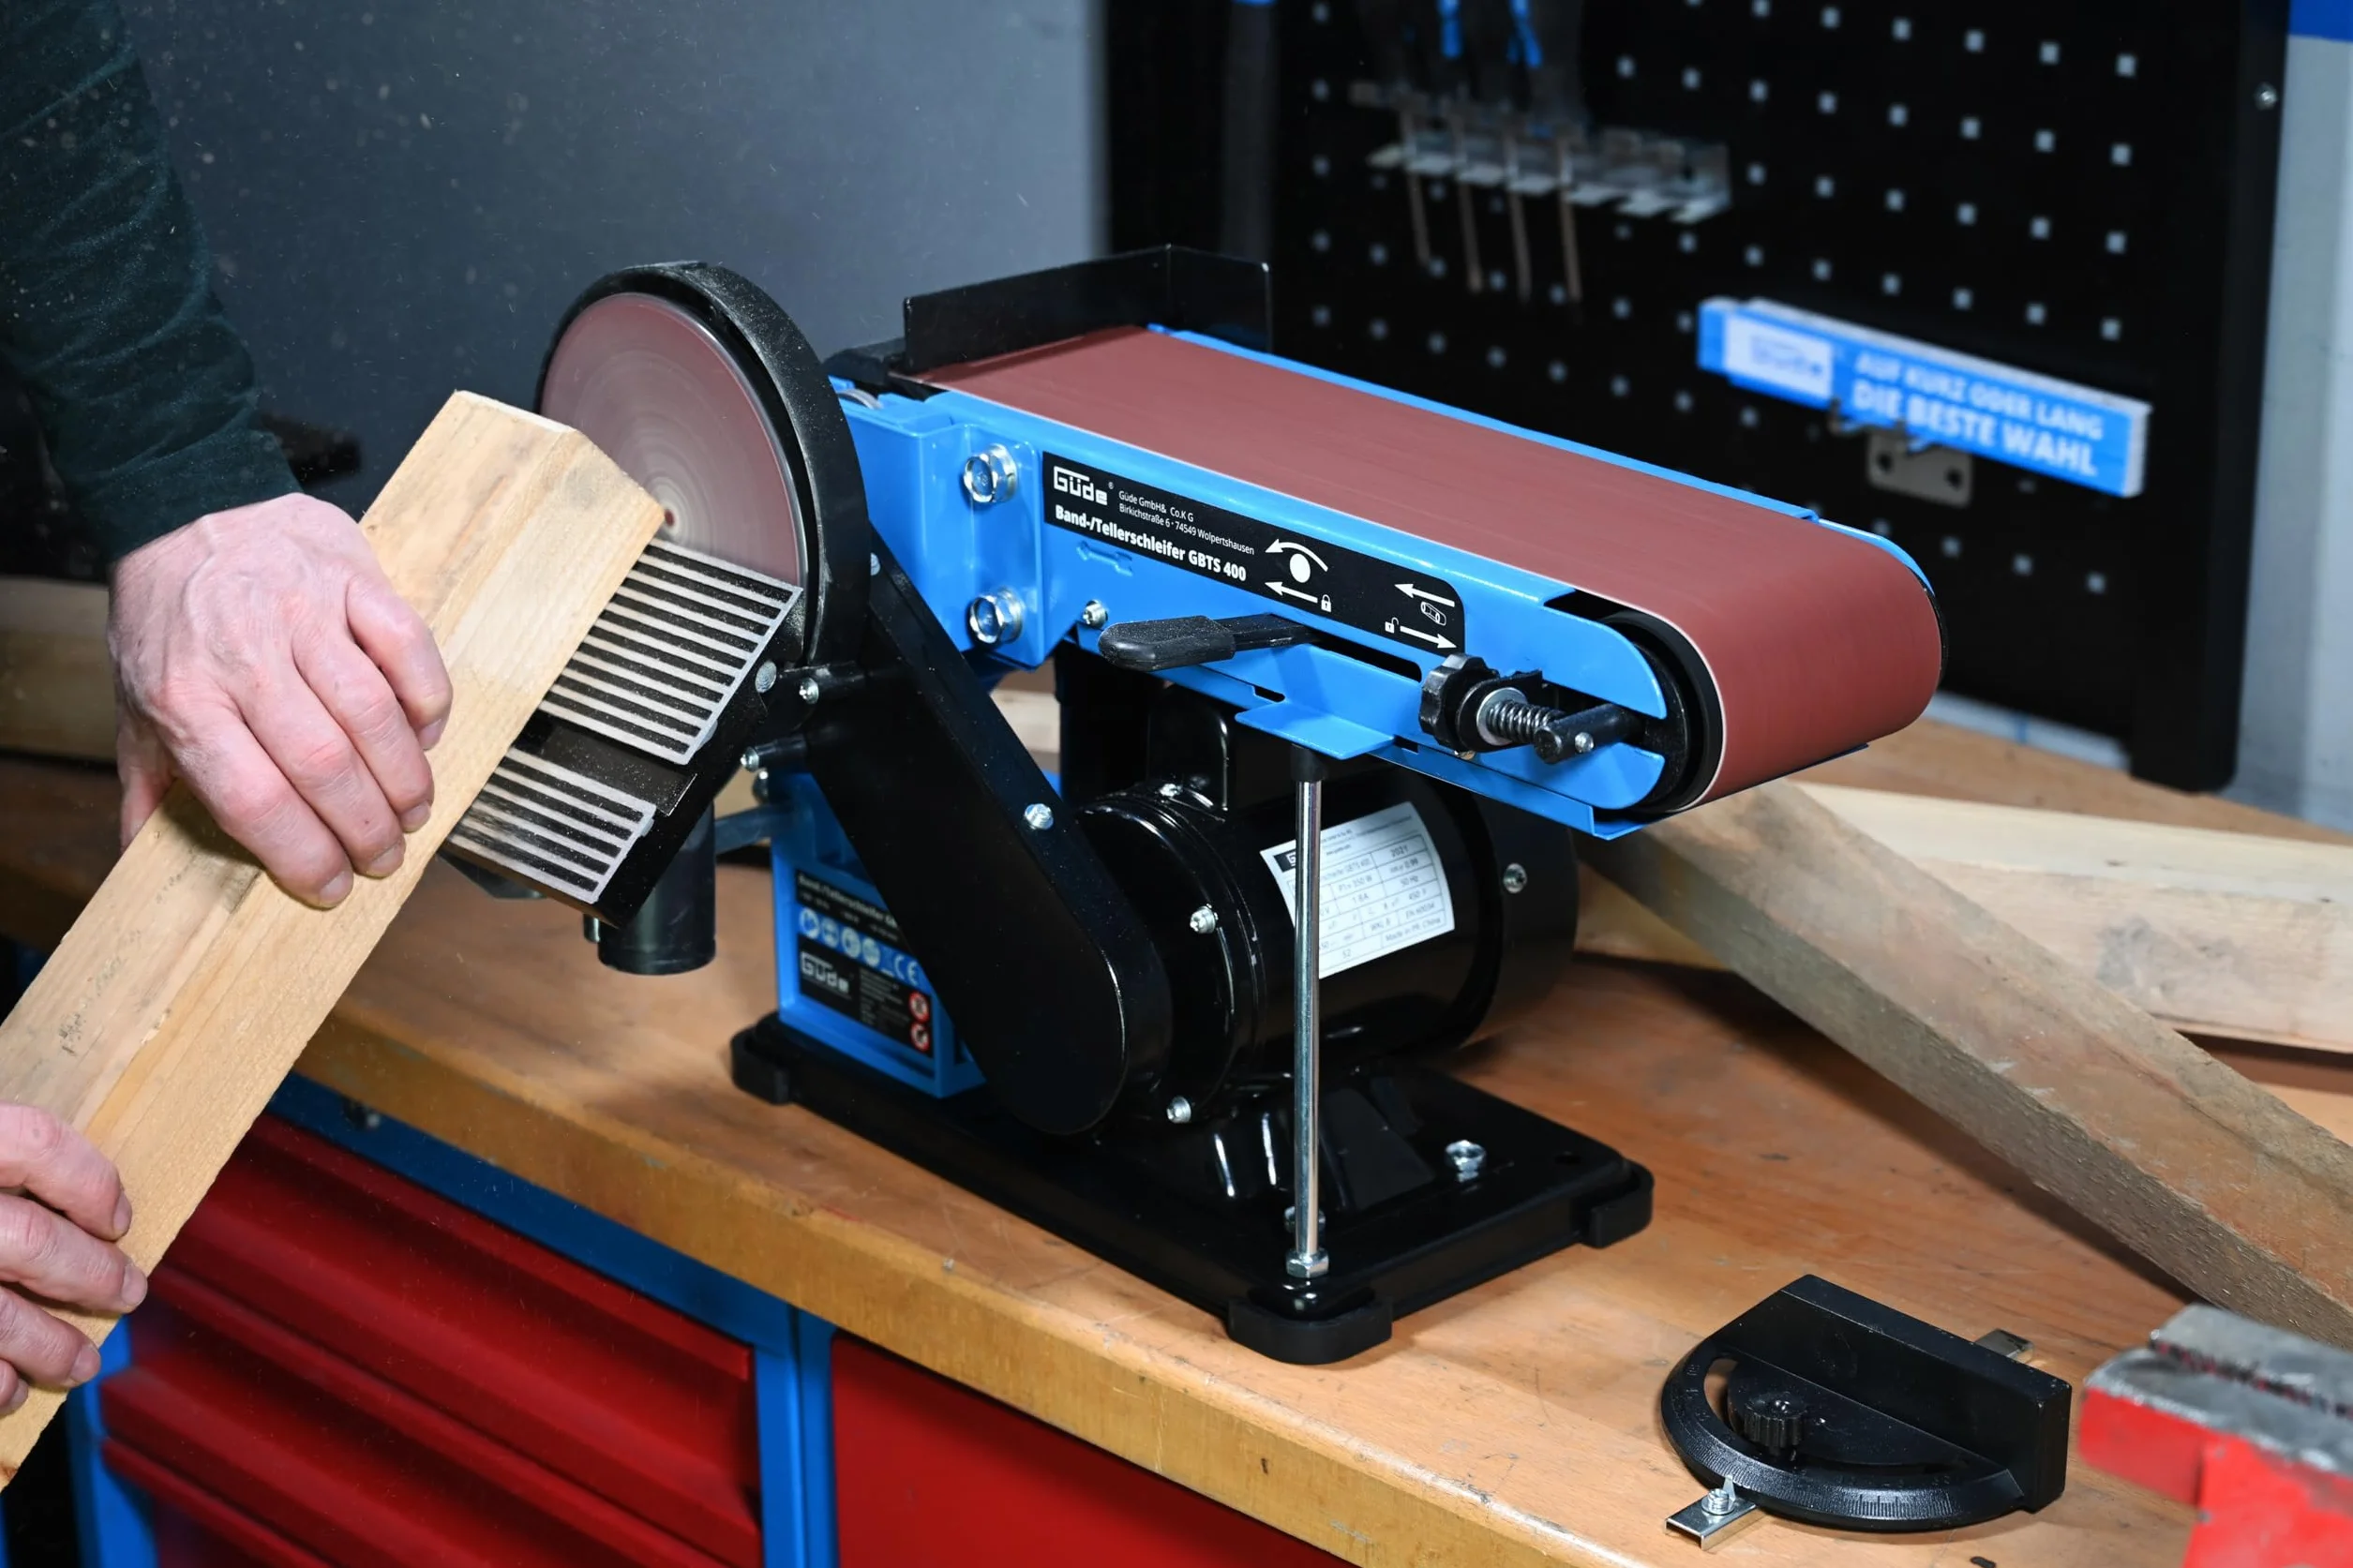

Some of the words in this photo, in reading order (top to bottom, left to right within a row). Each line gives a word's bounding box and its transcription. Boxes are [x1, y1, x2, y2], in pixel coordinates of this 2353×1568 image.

[1852, 378, 1902, 419] DIE
[1907, 393, 1996, 447] BESTE
[2002, 422, 2098, 477] WAHL
[1904, 366, 1966, 403] KURZ
[1970, 381, 2031, 421] ODER
[2036, 401, 2104, 441] LANG
[1054, 466, 1107, 505] Güde
[1118, 490, 1137, 504] Güde
[1055, 504, 1185, 561] Band-/Tellerschleifer
[1189, 550, 1221, 573] GBTS
[1223, 561, 1246, 581] 400
[1119, 503, 1164, 526] Birkichstraße
[1165, 518, 1170, 528] 6
[1175, 521, 1196, 536] 74549
[1197, 529, 1254, 555] Wolpertshausen
